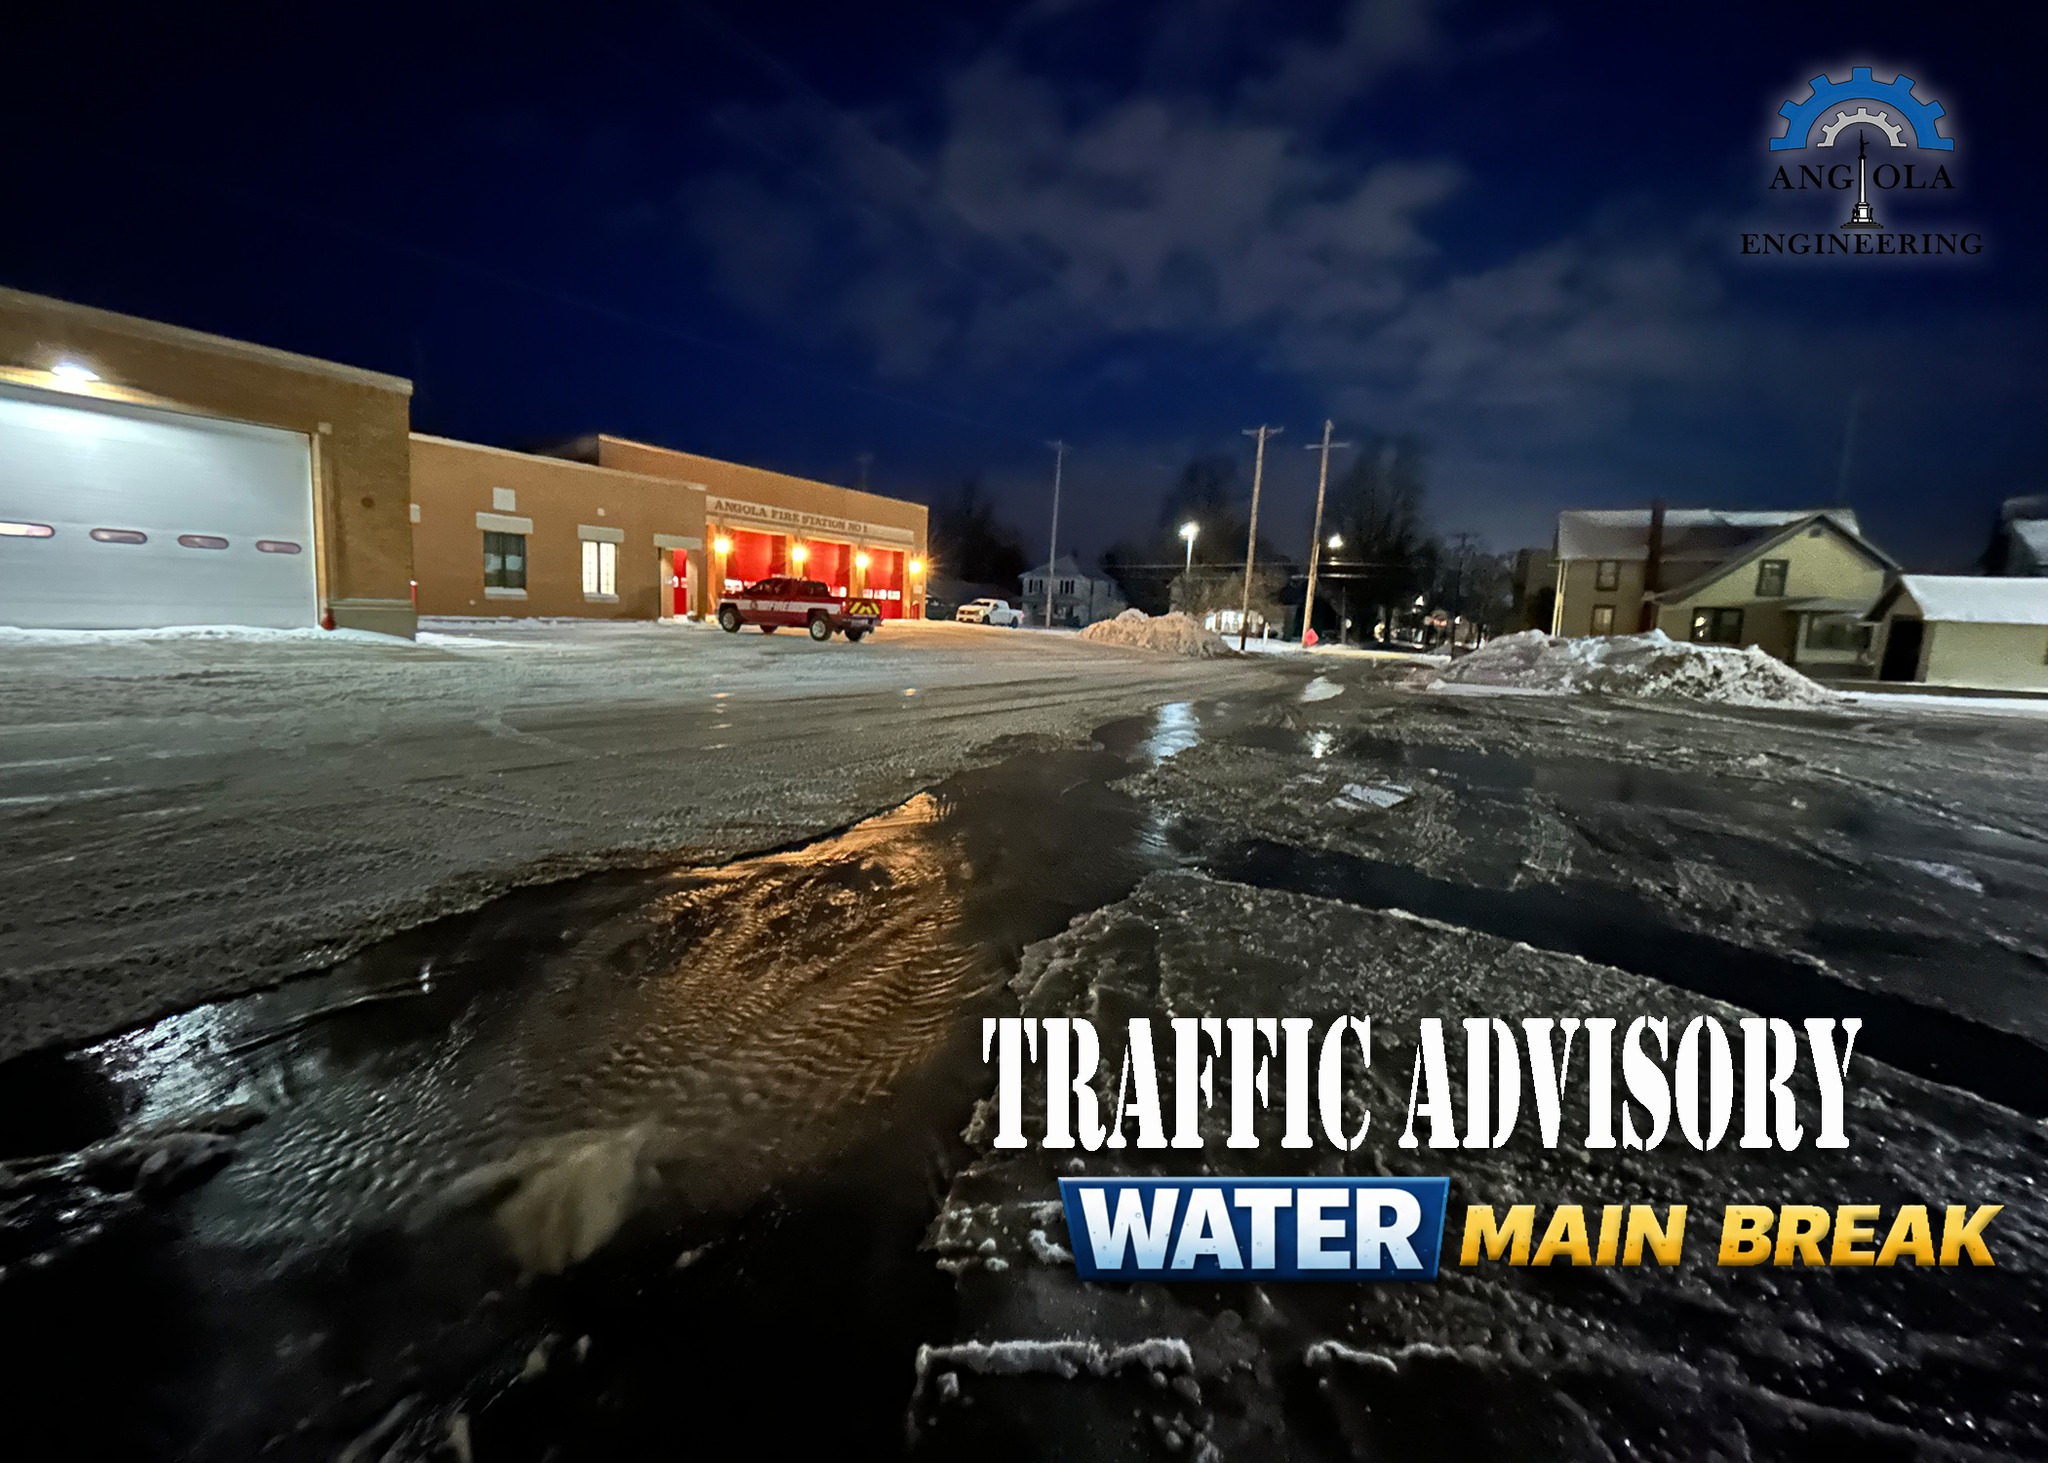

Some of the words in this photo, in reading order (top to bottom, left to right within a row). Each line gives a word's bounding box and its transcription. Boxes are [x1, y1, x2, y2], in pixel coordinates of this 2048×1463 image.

[714, 499, 767, 518] ANGOLA
[771, 508, 800, 524] FIRE
[802, 516, 845, 530] STATION
[847, 521, 862, 533] NO
[862, 524, 869, 534] 1
